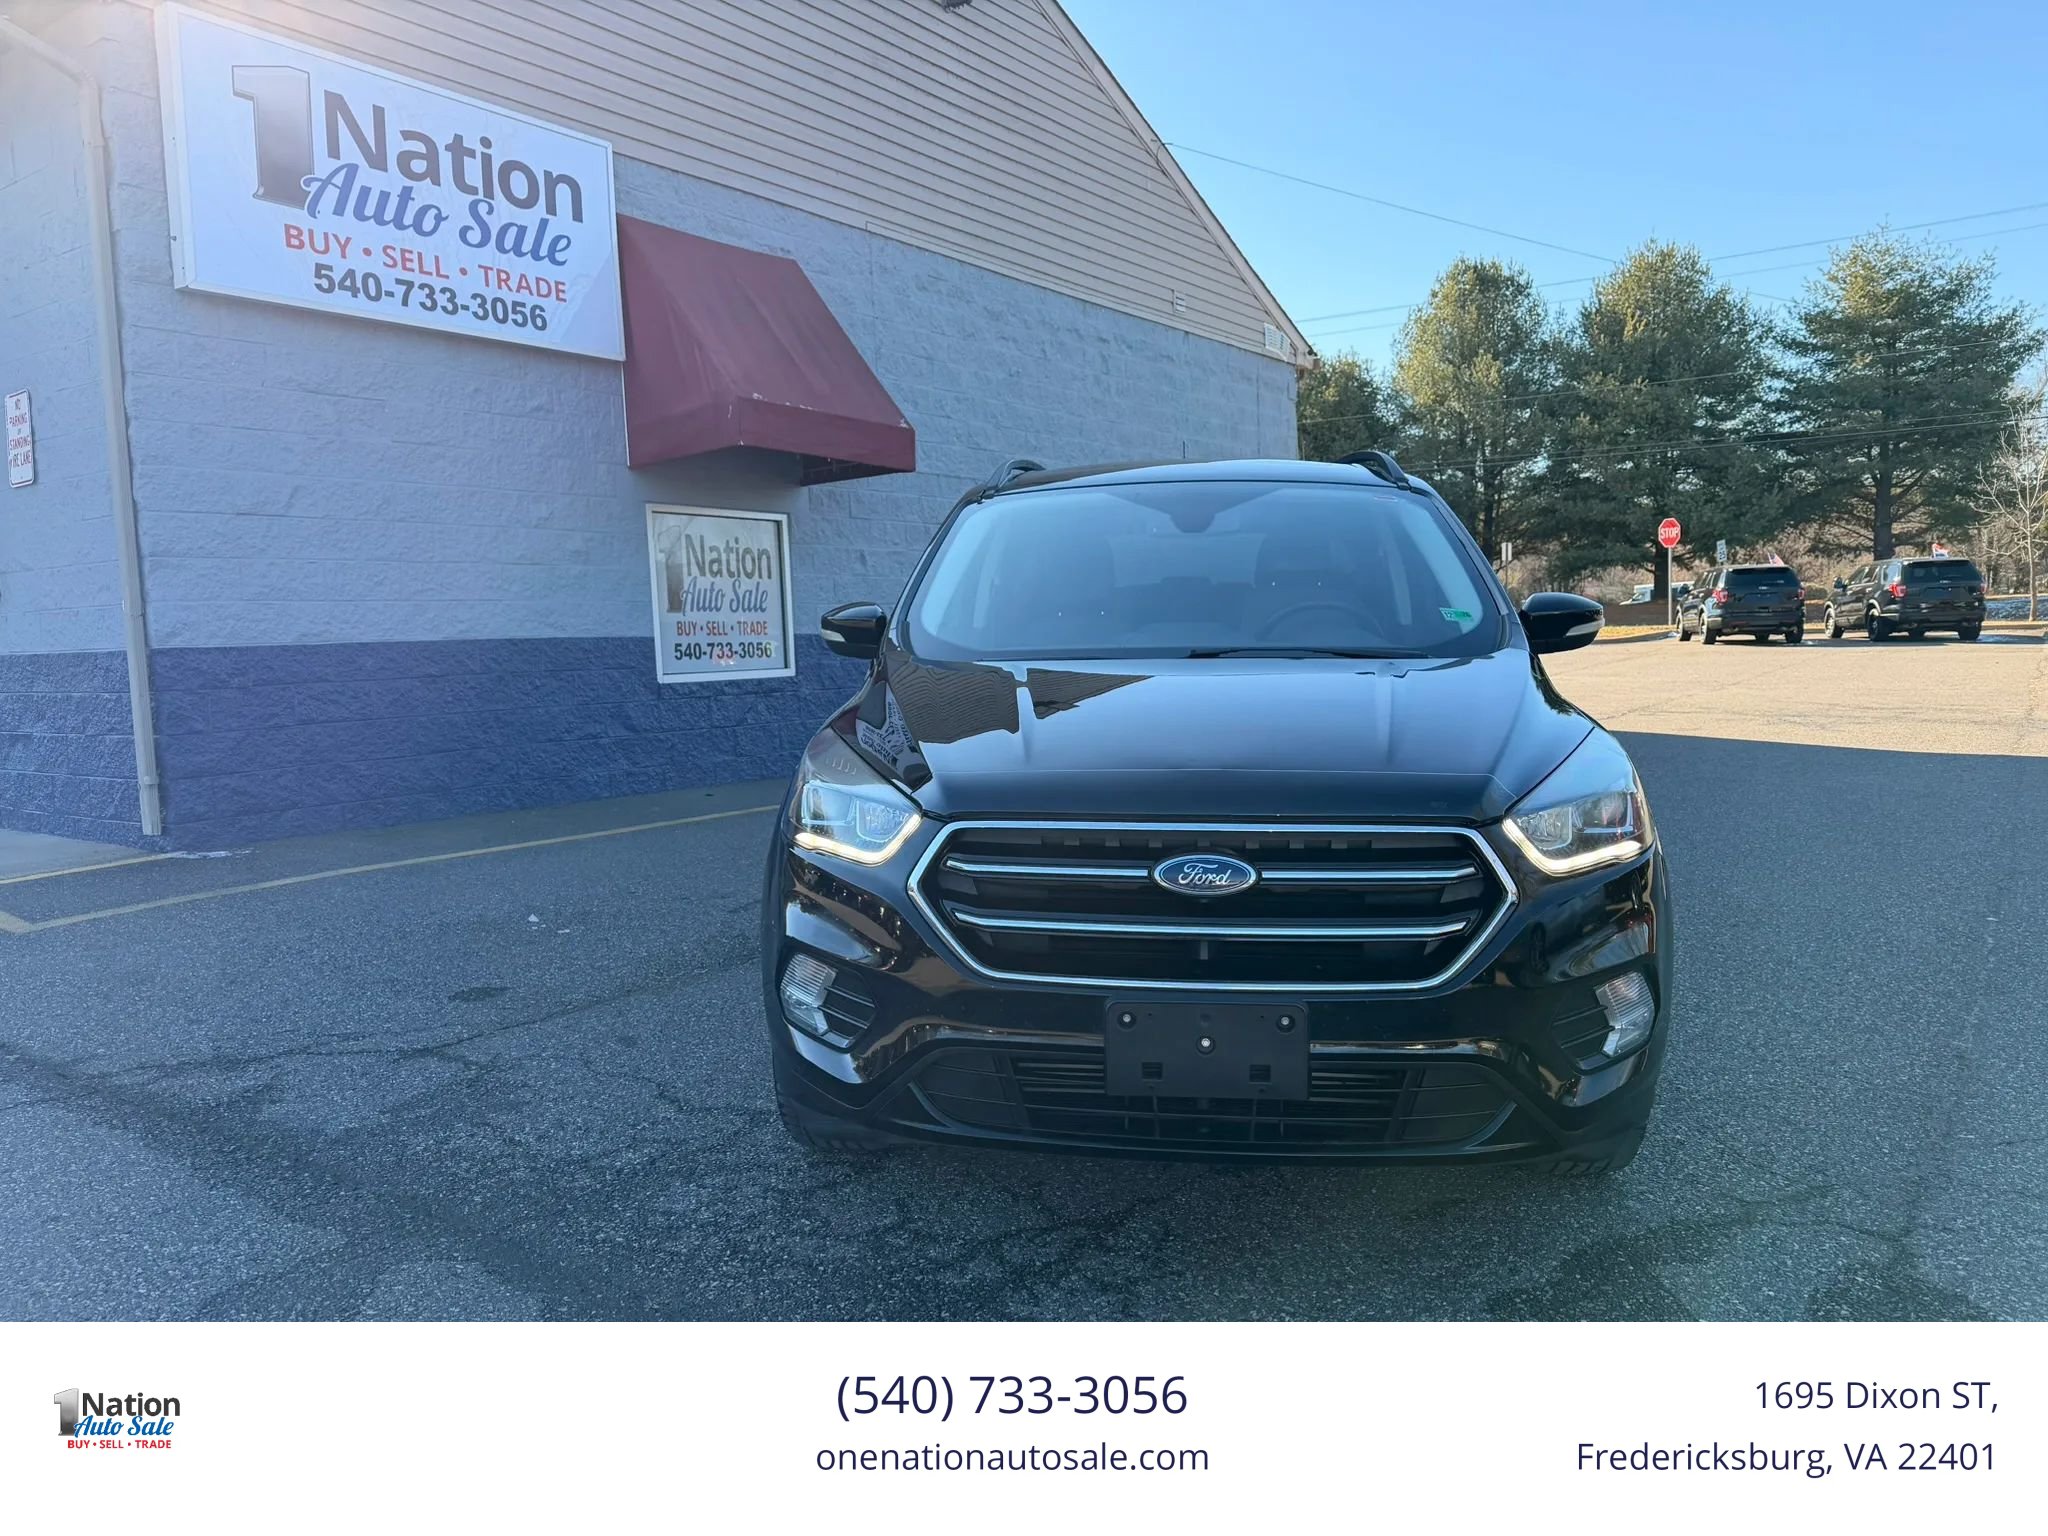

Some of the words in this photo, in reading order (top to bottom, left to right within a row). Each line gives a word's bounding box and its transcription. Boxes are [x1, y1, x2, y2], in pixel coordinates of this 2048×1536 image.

[232, 64, 314, 210] 1
[323, 89, 584, 223] Nation
[301, 162, 449, 238] Auto
[458, 198, 572, 266] Sale
[283, 223, 352, 259] BUY
[382, 245, 450, 280] SELL
[478, 264, 568, 303] TRADE
[313, 262, 549, 331] 540-733-3056
[1660, 526, 1679, 539] STOP
[685, 533, 772, 580] Nation
[681, 576, 725, 616] Auto
[729, 578, 768, 613] Sale
[676, 620, 698, 636] BUY
[706, 621, 728, 636] SELL
[737, 621, 768, 636] TRADE
[674, 641, 772, 660] 540-733-3056
[1178, 862, 1232, 886] Ford
